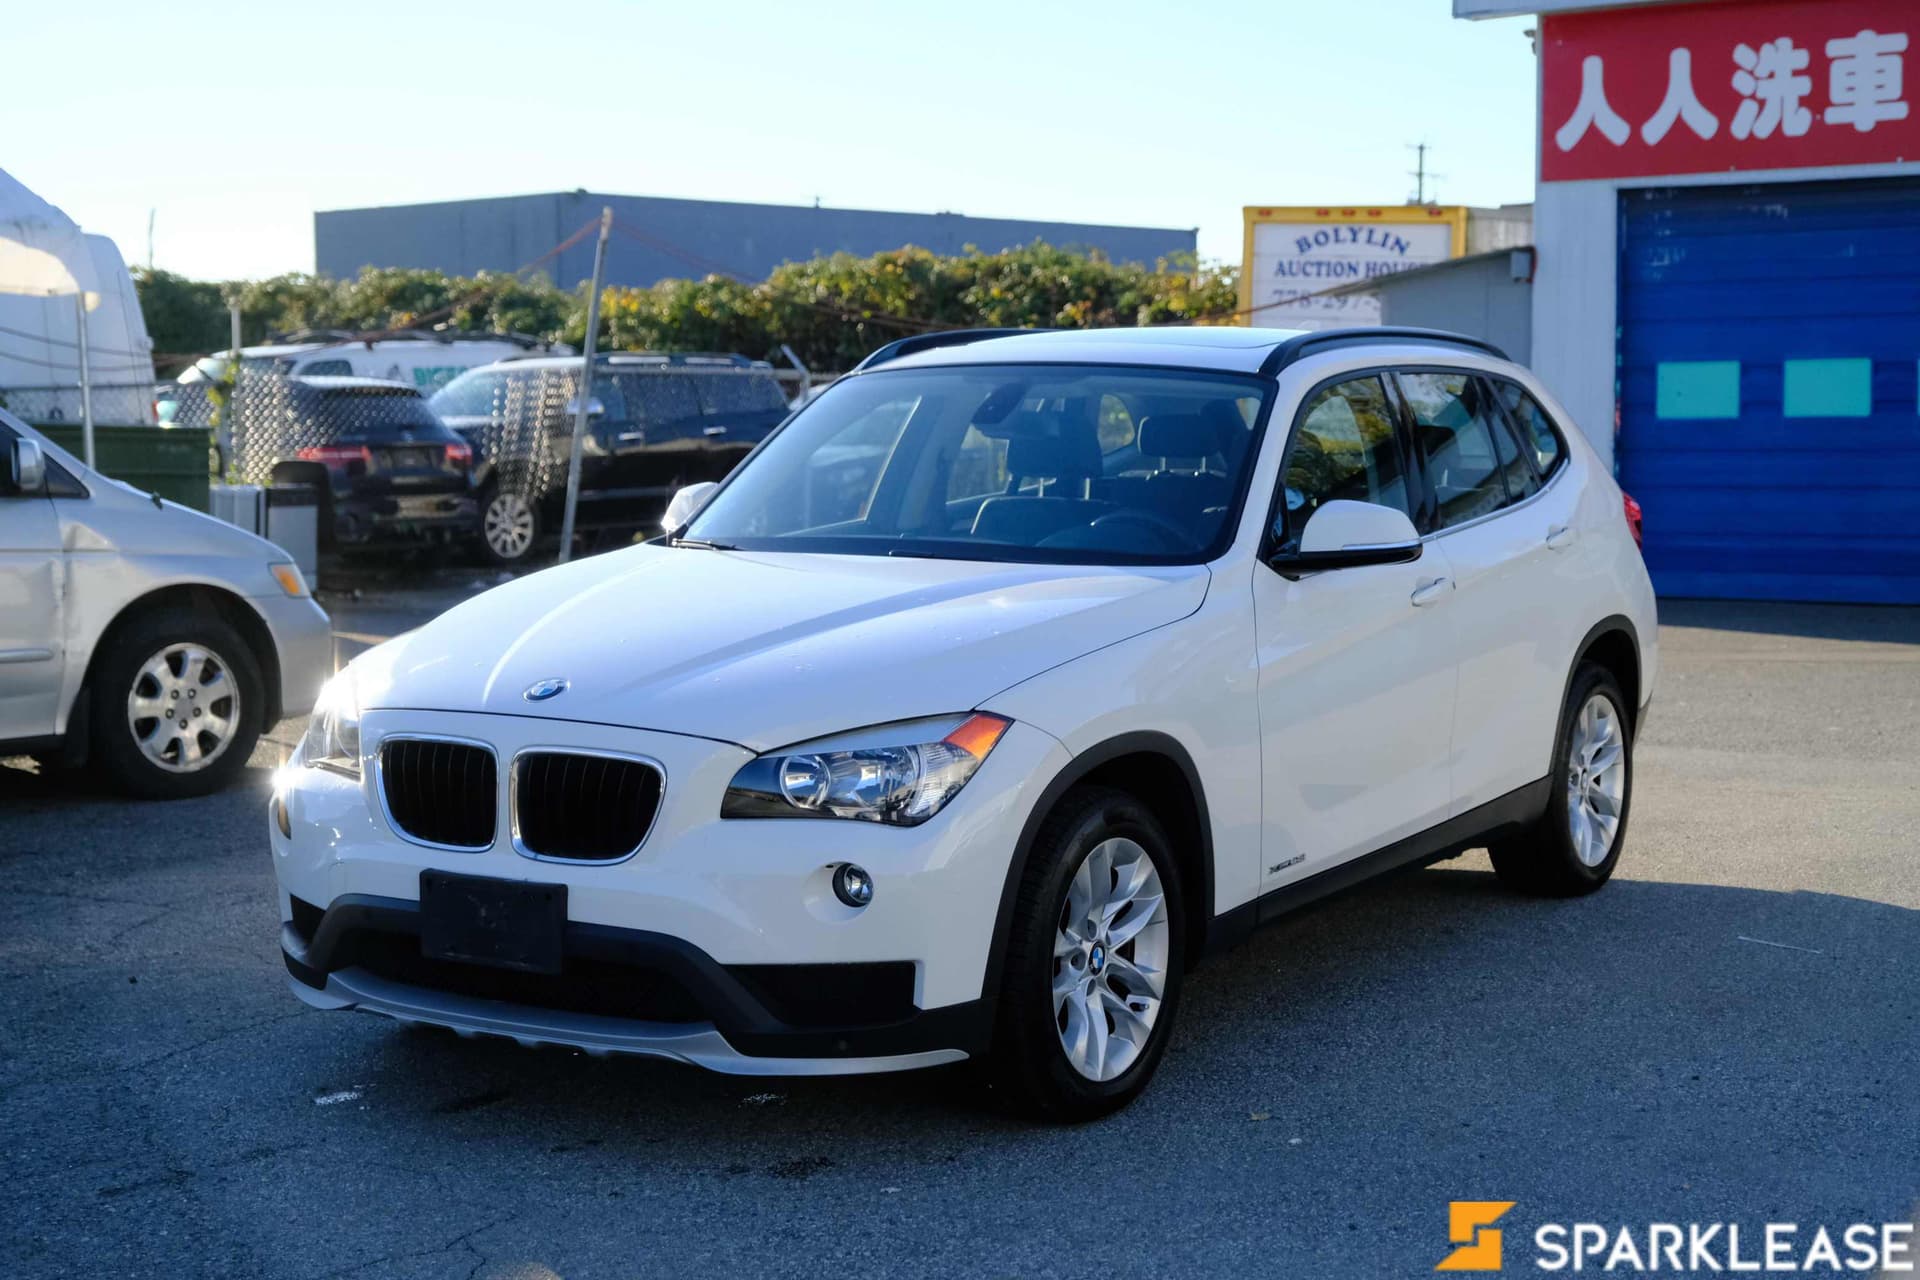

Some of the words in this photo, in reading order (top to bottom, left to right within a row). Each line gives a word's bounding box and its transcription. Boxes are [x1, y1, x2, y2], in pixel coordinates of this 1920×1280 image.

[1555, 29, 1909, 152] 人人洗車
[1294, 225, 1411, 256] BOLYLIN
[1274, 260, 1359, 277] AUCTION
[1364, 260, 1425, 278] HOU
